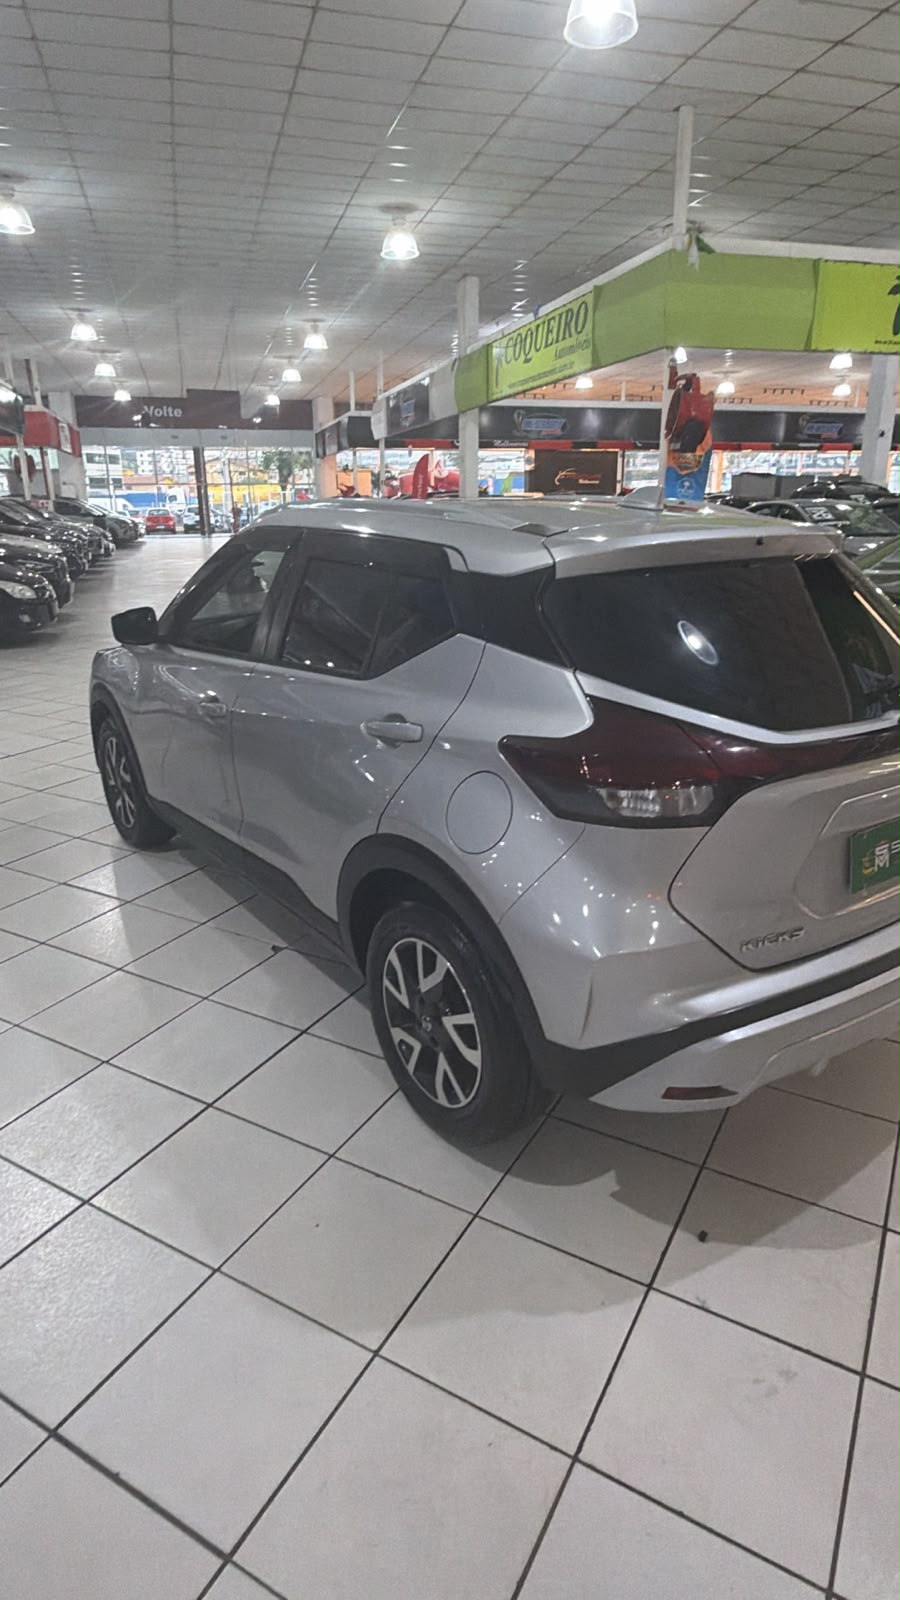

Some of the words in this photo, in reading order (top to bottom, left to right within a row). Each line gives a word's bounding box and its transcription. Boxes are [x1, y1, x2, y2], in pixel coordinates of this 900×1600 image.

[504, 300, 589, 365] COQUEIRO
[143, 405, 183, 417] Volte
[740, 926, 807, 954] KICKS
